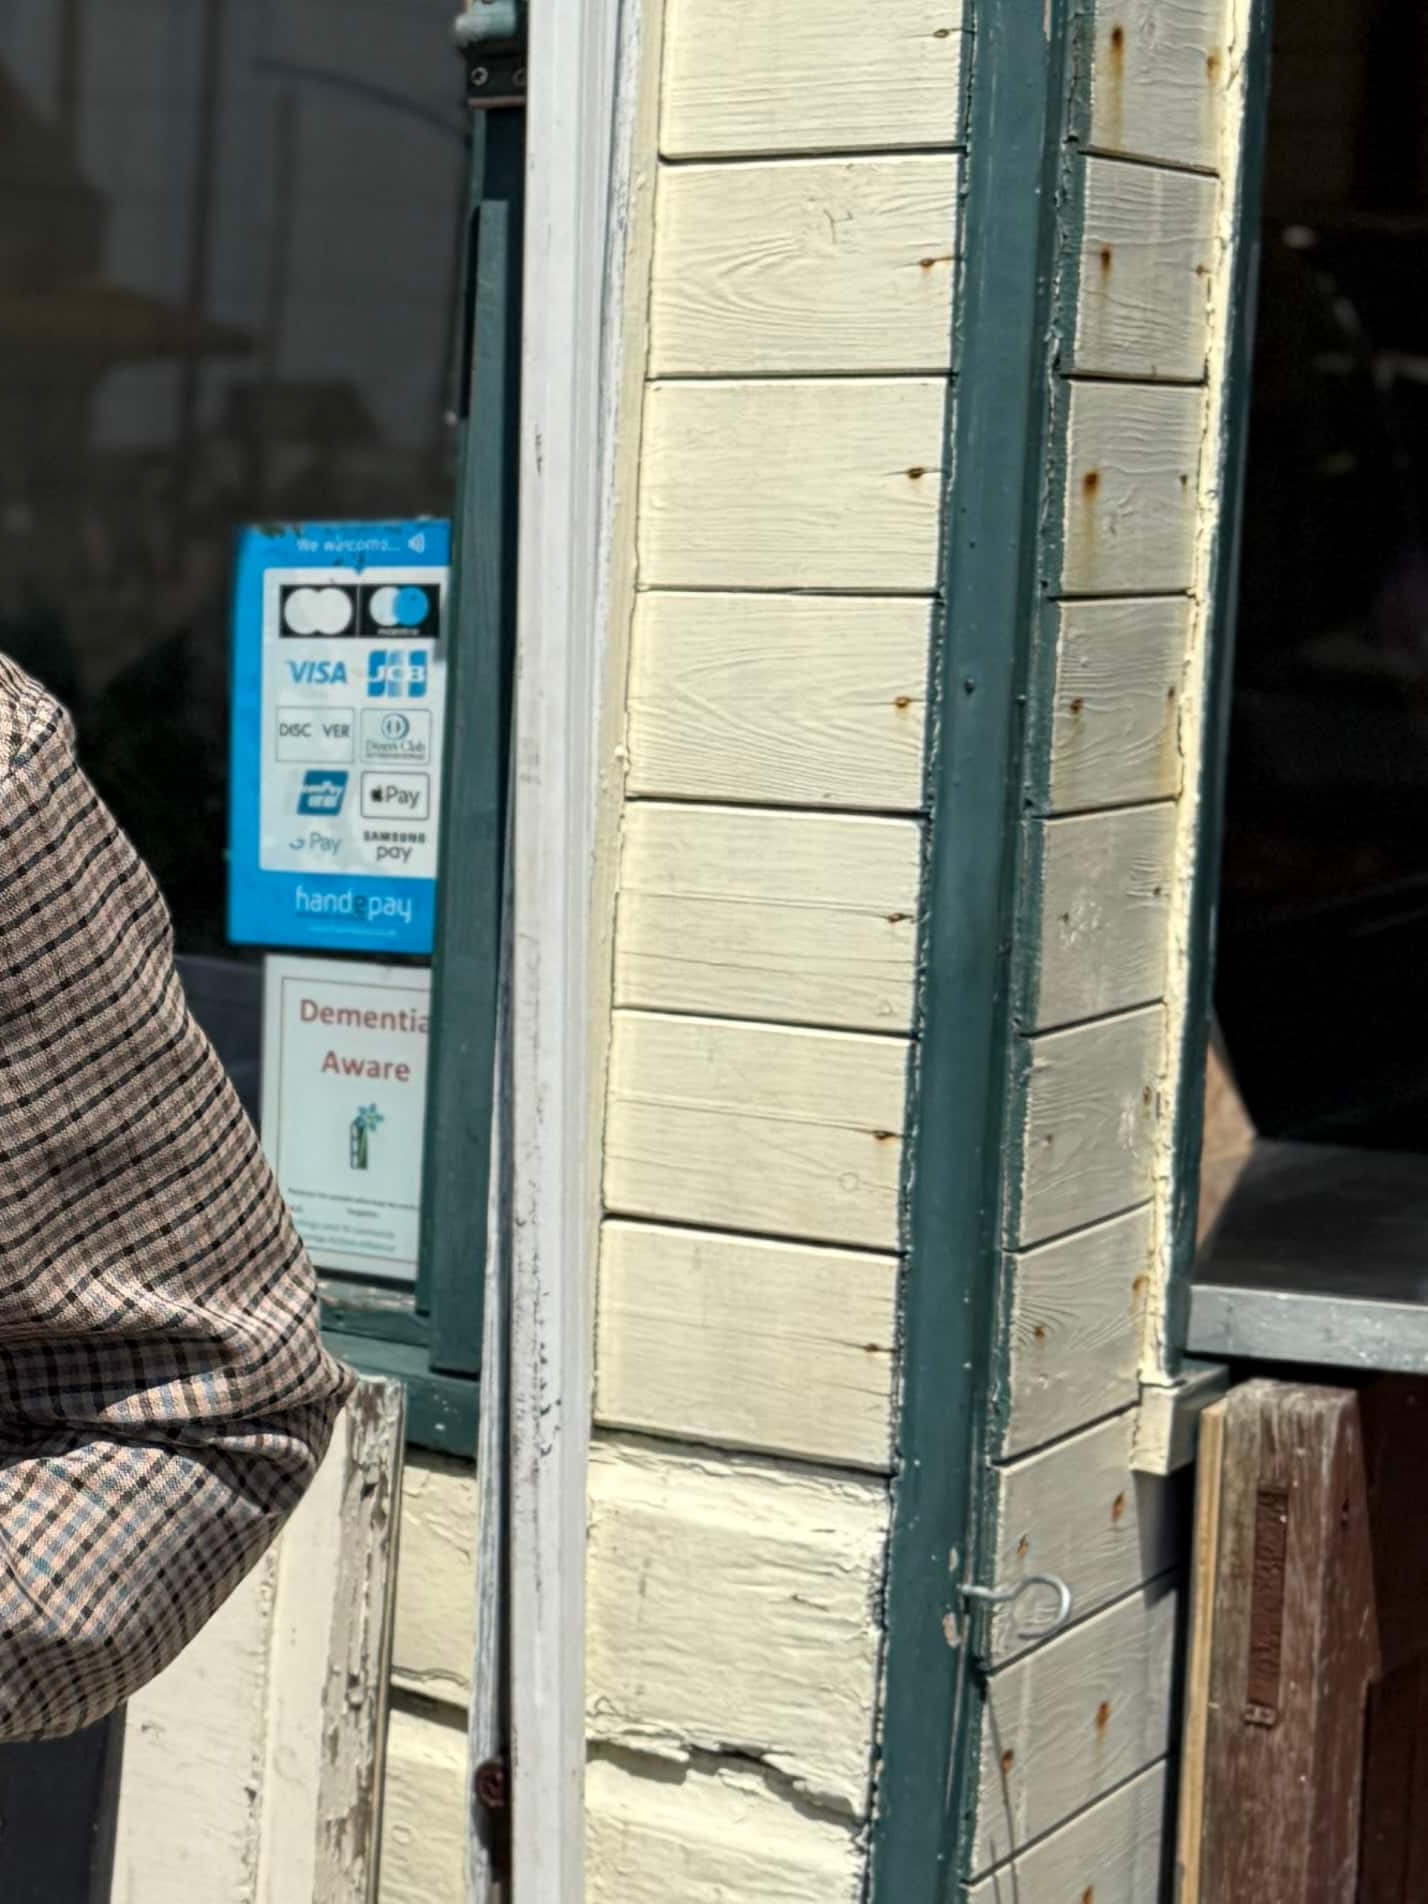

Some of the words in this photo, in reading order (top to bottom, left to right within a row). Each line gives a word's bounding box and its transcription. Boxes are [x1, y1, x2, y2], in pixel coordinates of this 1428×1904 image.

[288, 660, 348, 685] VISA
[278, 722, 351, 739] DISCVER
[385, 785, 420, 809] Pay
[309, 831, 343, 856] Pay
[362, 830, 427, 844] SAMSUNG
[375, 846, 413, 865] pay
[300, 998, 431, 1034] Dementia
[321, 1050, 411, 1082] Aware
